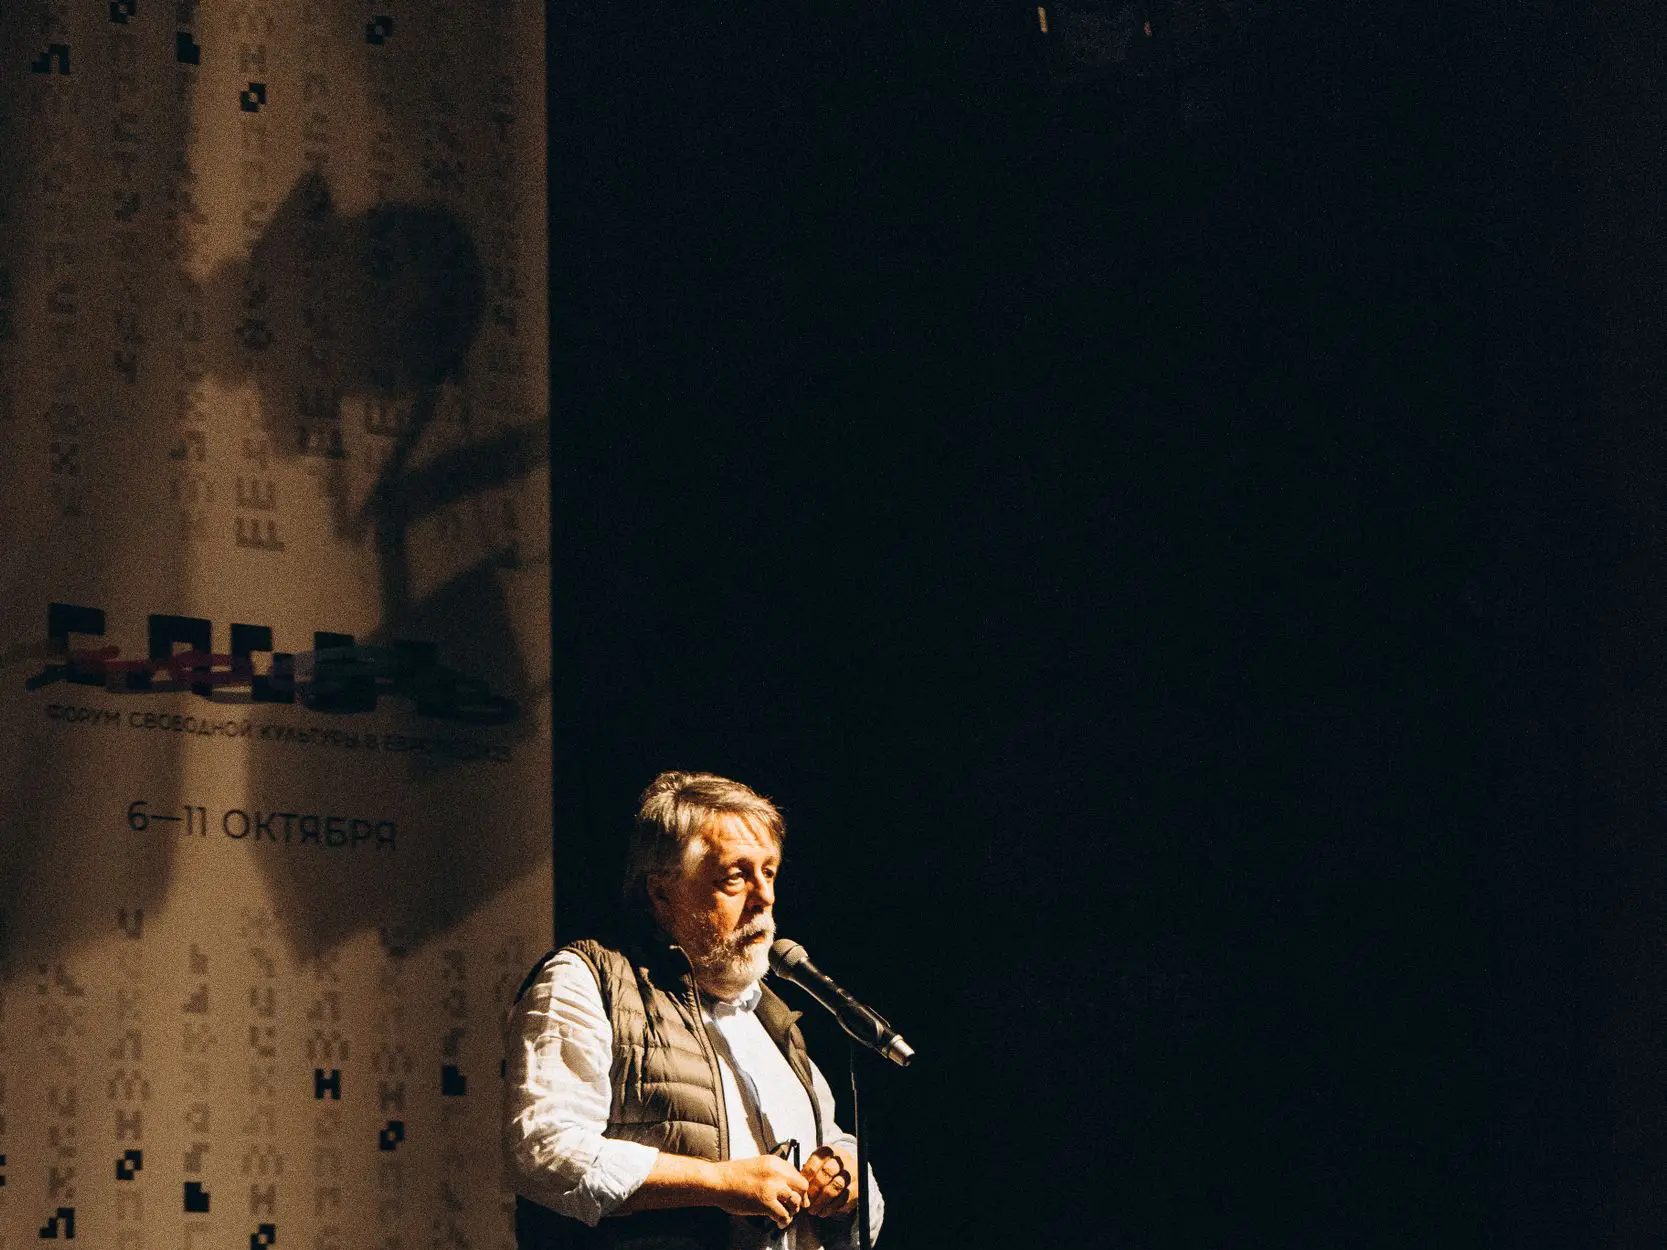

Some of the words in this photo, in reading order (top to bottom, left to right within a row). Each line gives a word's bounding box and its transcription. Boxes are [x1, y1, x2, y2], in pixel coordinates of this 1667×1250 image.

[46, 703, 121, 726] ФОРУМ
[129, 711, 253, 739] СВОБОДНОЙ
[221, 808, 398, 851] ОКТЯБРЯ
